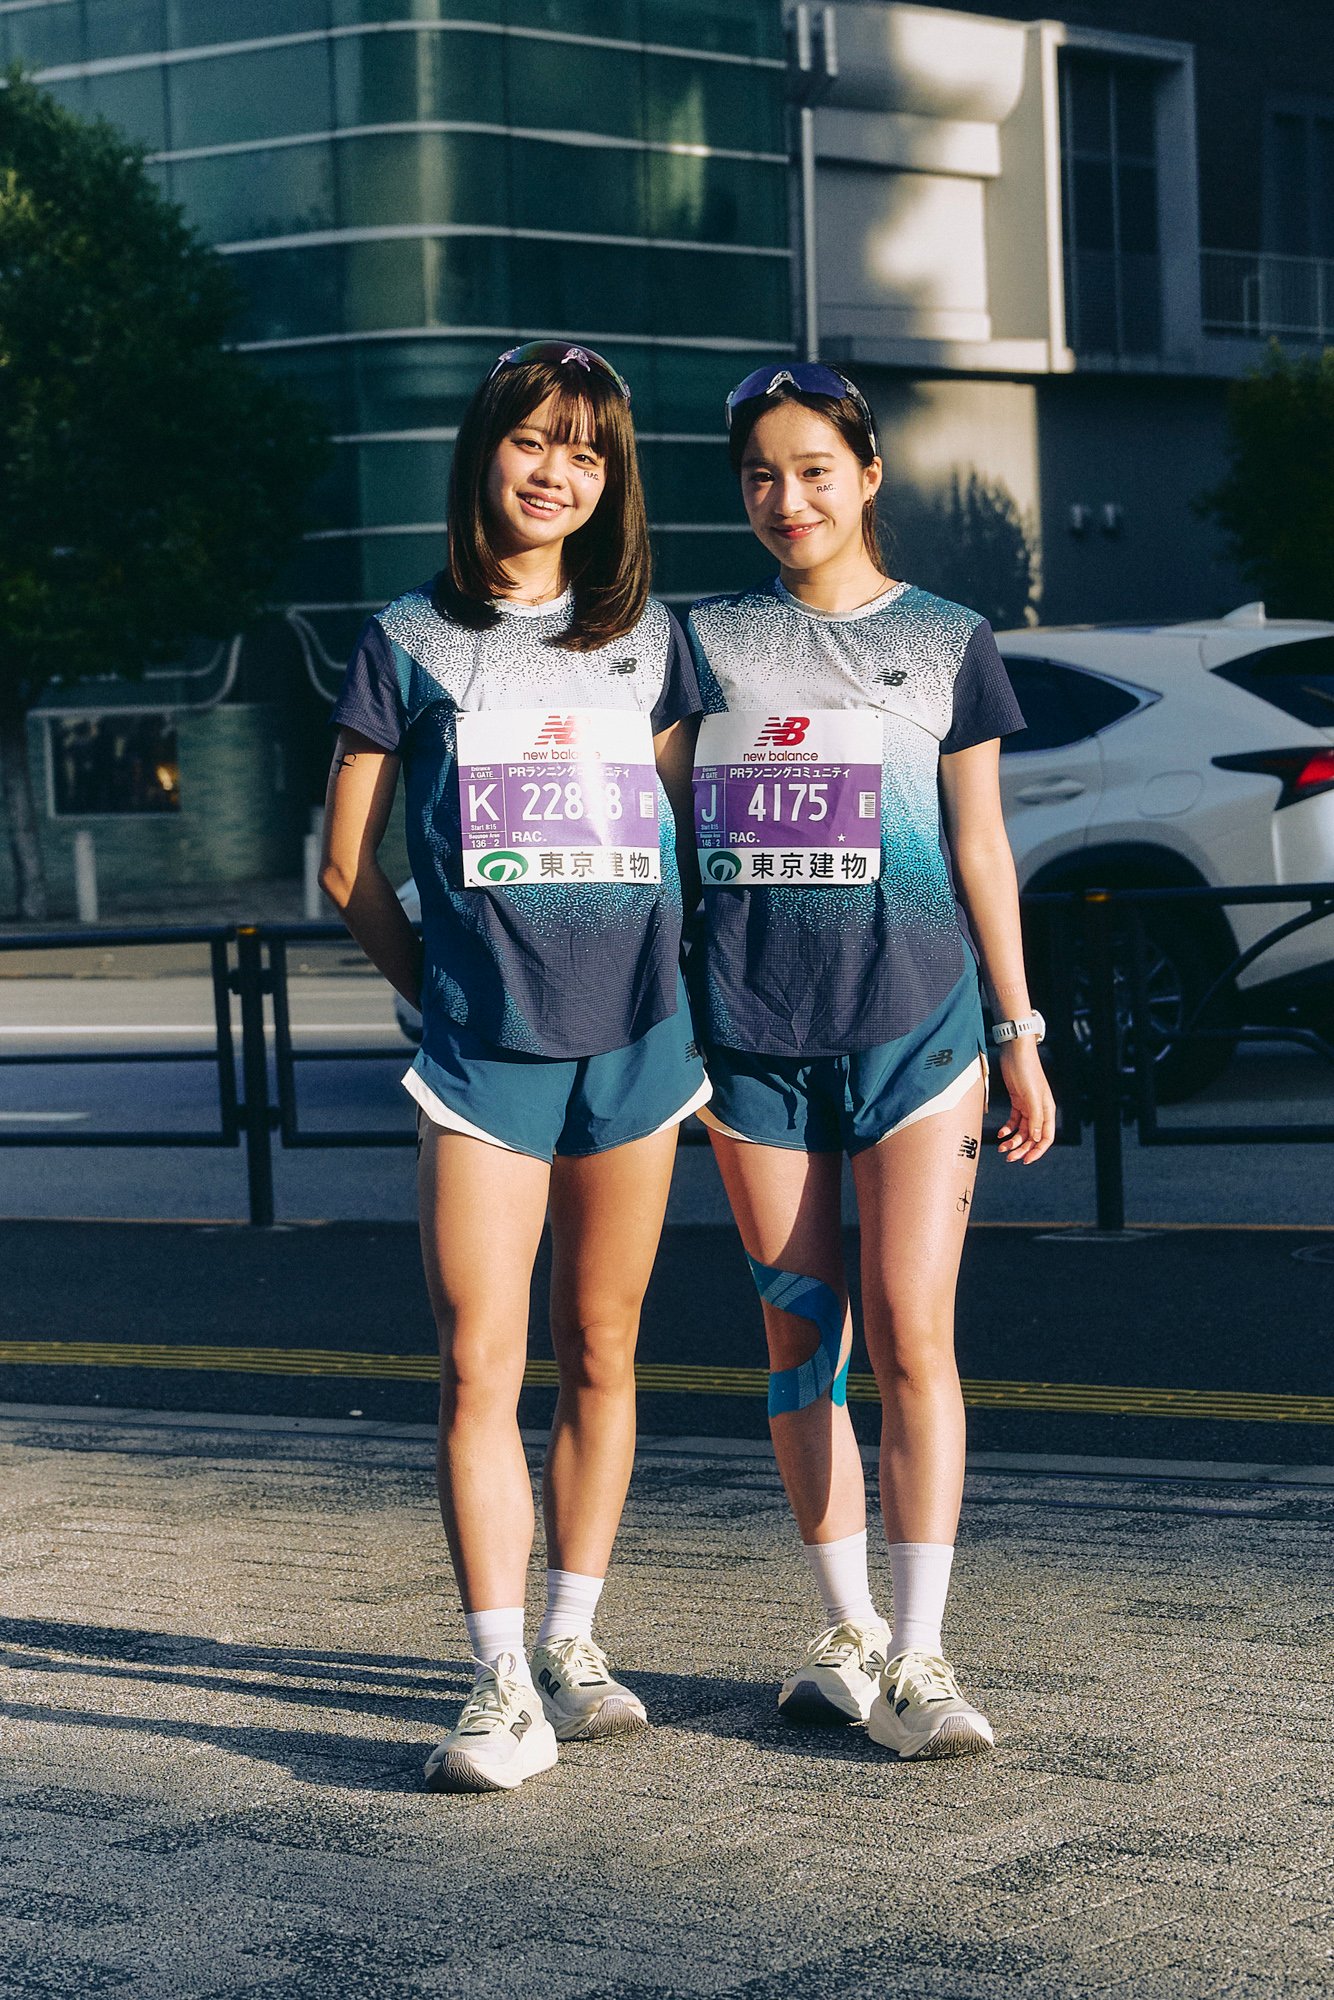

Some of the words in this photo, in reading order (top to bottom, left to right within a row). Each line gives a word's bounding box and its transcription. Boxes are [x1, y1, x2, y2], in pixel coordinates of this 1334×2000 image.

[754, 716, 811, 747] NB
[523, 751, 548, 760] new
[551, 749, 601, 760] balae
[743, 752, 767, 762] new
[768, 750, 819, 762] balance
[508, 766, 630, 778] PRランニングニティ
[729, 766, 851, 779] PRランニングコミュニティ
[468, 783, 501, 822] K
[520, 782, 624, 821] 2288
[701, 784, 717, 822] J
[748, 783, 828, 822] 4175
[511, 831, 547, 842] RAC.
[729, 831, 761, 843] RAC.
[751, 852, 867, 880] 東京建物
